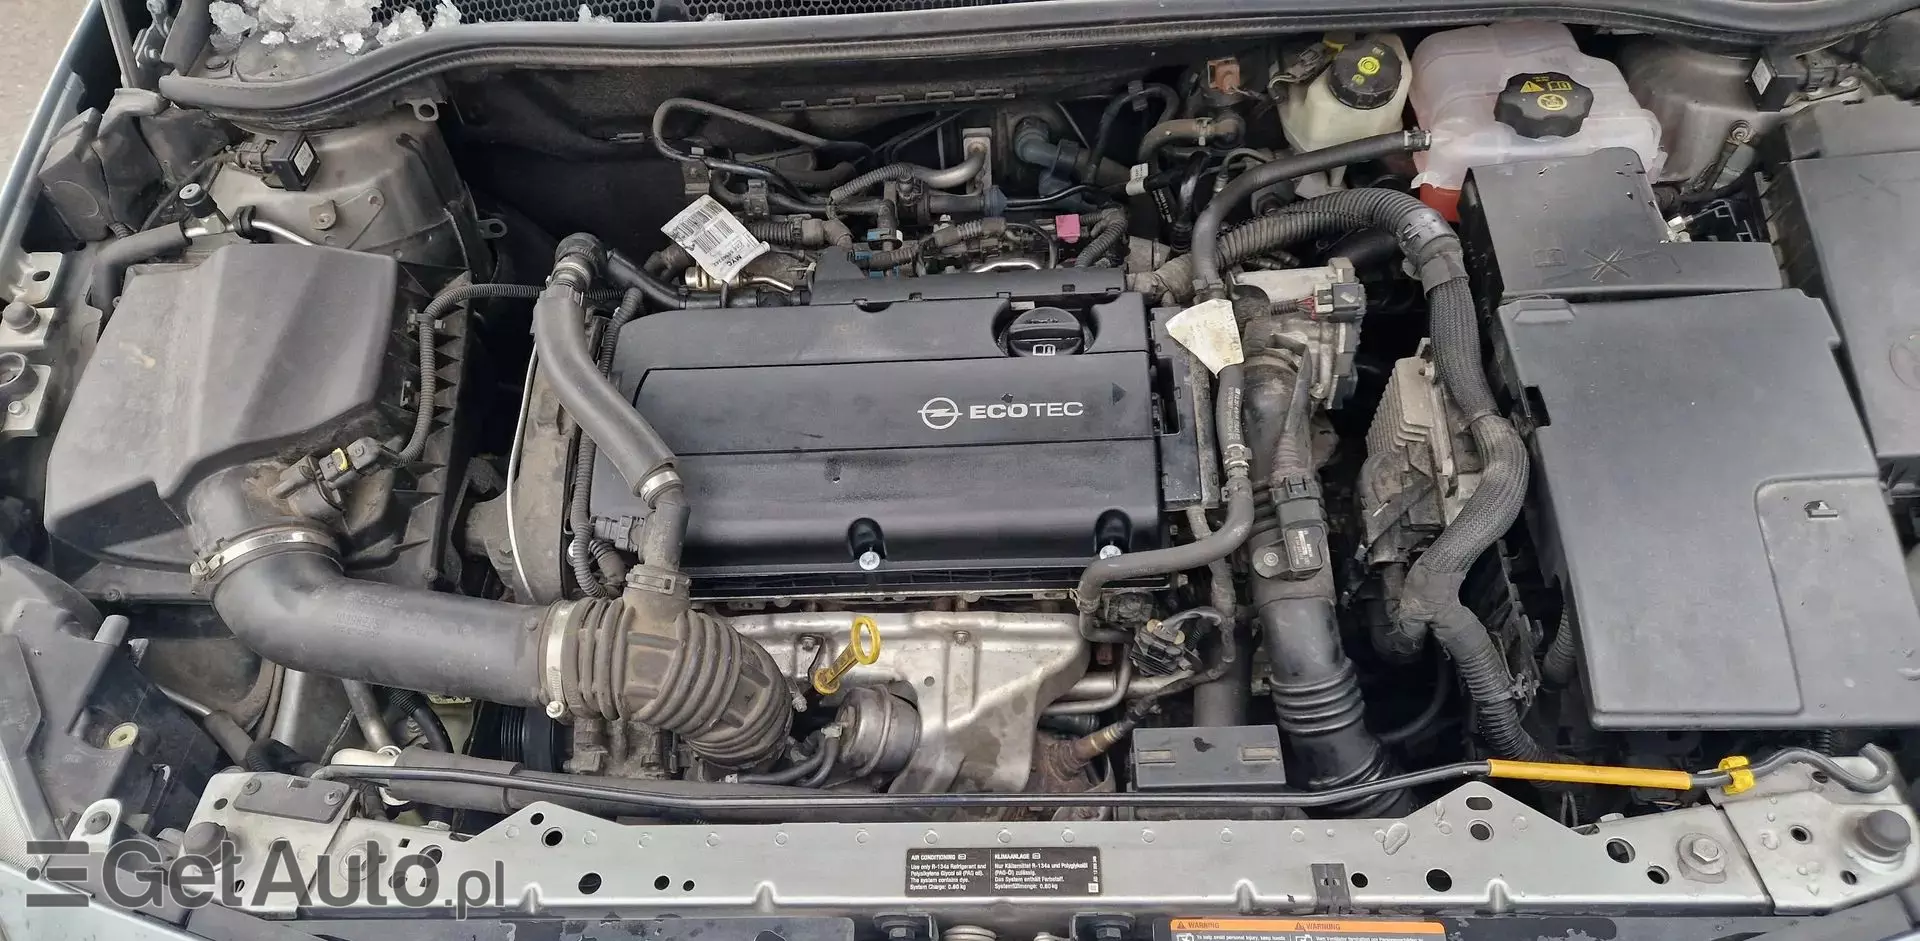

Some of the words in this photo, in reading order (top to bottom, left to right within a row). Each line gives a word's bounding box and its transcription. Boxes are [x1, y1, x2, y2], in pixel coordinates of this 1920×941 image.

[726, 254, 742, 267] MYC
[969, 401, 1084, 419] ECOTEC
[1306, 922, 1340, 930] WARNUNG
